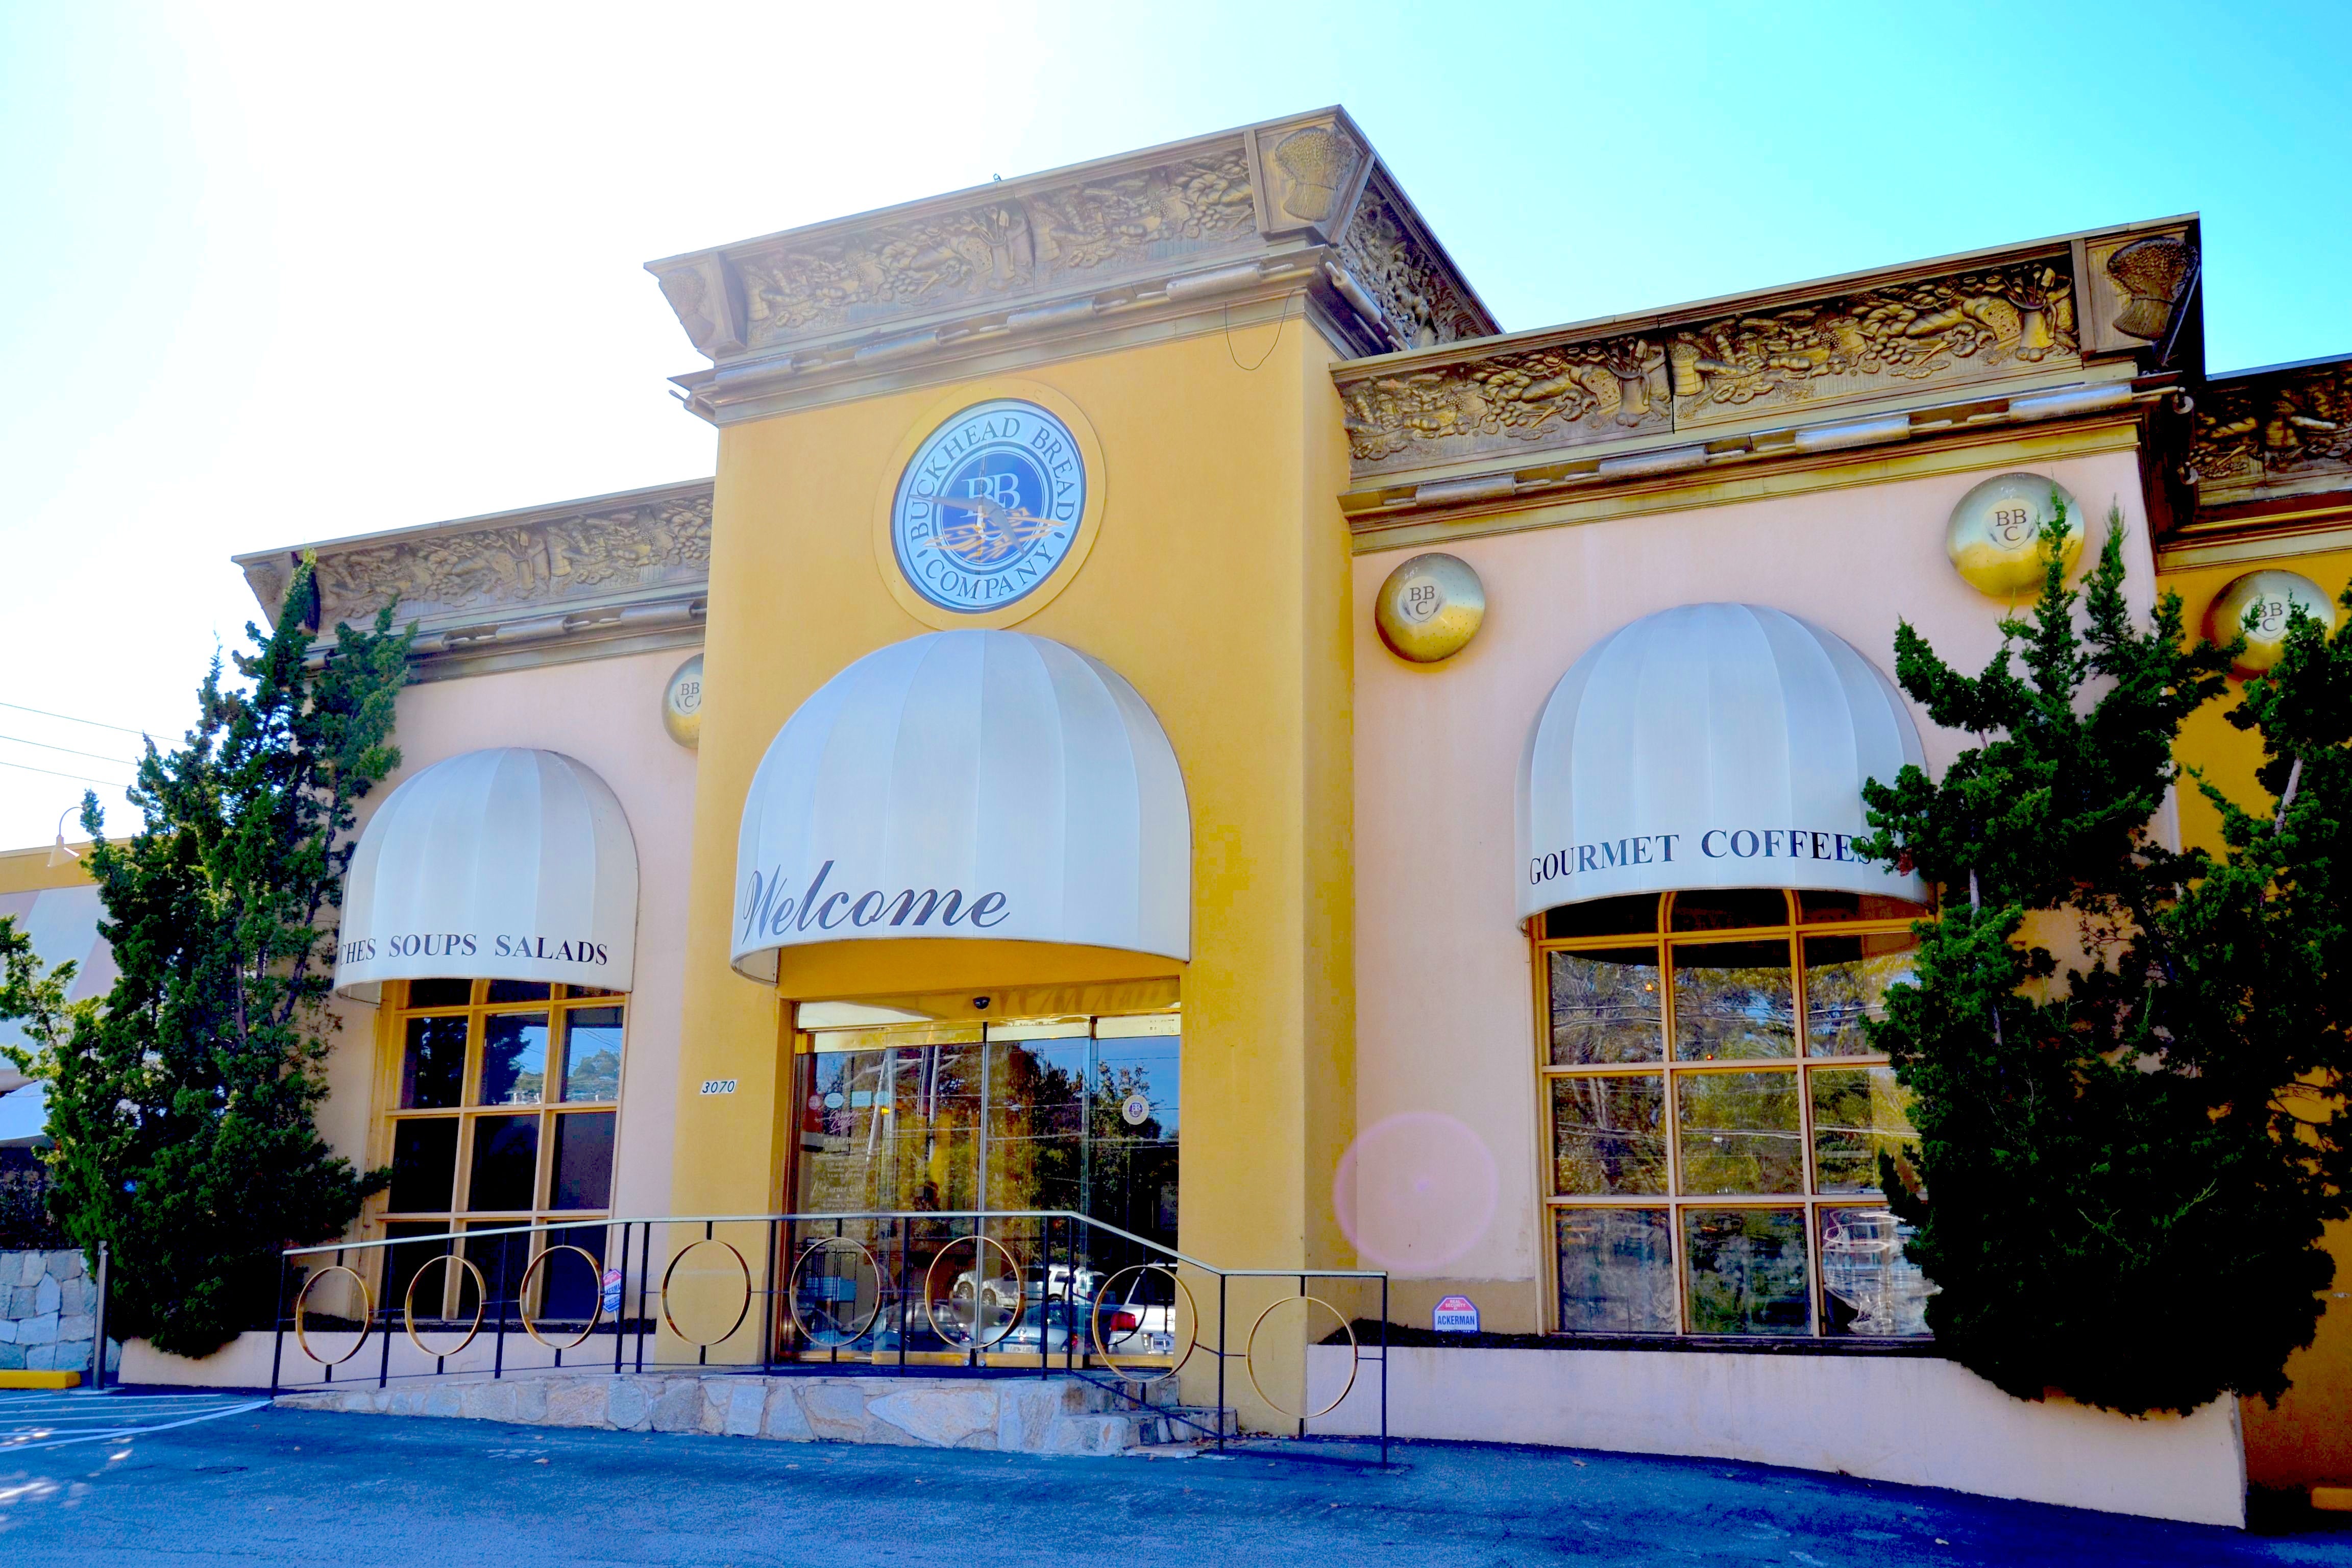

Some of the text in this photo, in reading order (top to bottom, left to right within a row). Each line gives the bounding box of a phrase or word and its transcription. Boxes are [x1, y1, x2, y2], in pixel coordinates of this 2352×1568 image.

[910, 417, 1075, 543] BUCKHEAD BREAD
[1995, 508, 2027, 527] BB
[2004, 526, 2020, 541] C
[925, 541, 1054, 600] COMPANY
[1409, 585, 1435, 601] BB
[1415, 601, 1429, 615] C
[2262, 618, 2278, 632] C
[680, 682, 700, 696] BB
[684, 696, 694, 707] C
[1530, 834, 1680, 886] GOURMET
[741, 860, 1010, 945] Welcome
[388, 934, 477, 958] SOUPS
[495, 935, 607, 966] SALADS
[702, 1081, 735, 1093] 3070
[1437, 1315, 1475, 1325] ACKERMAN
